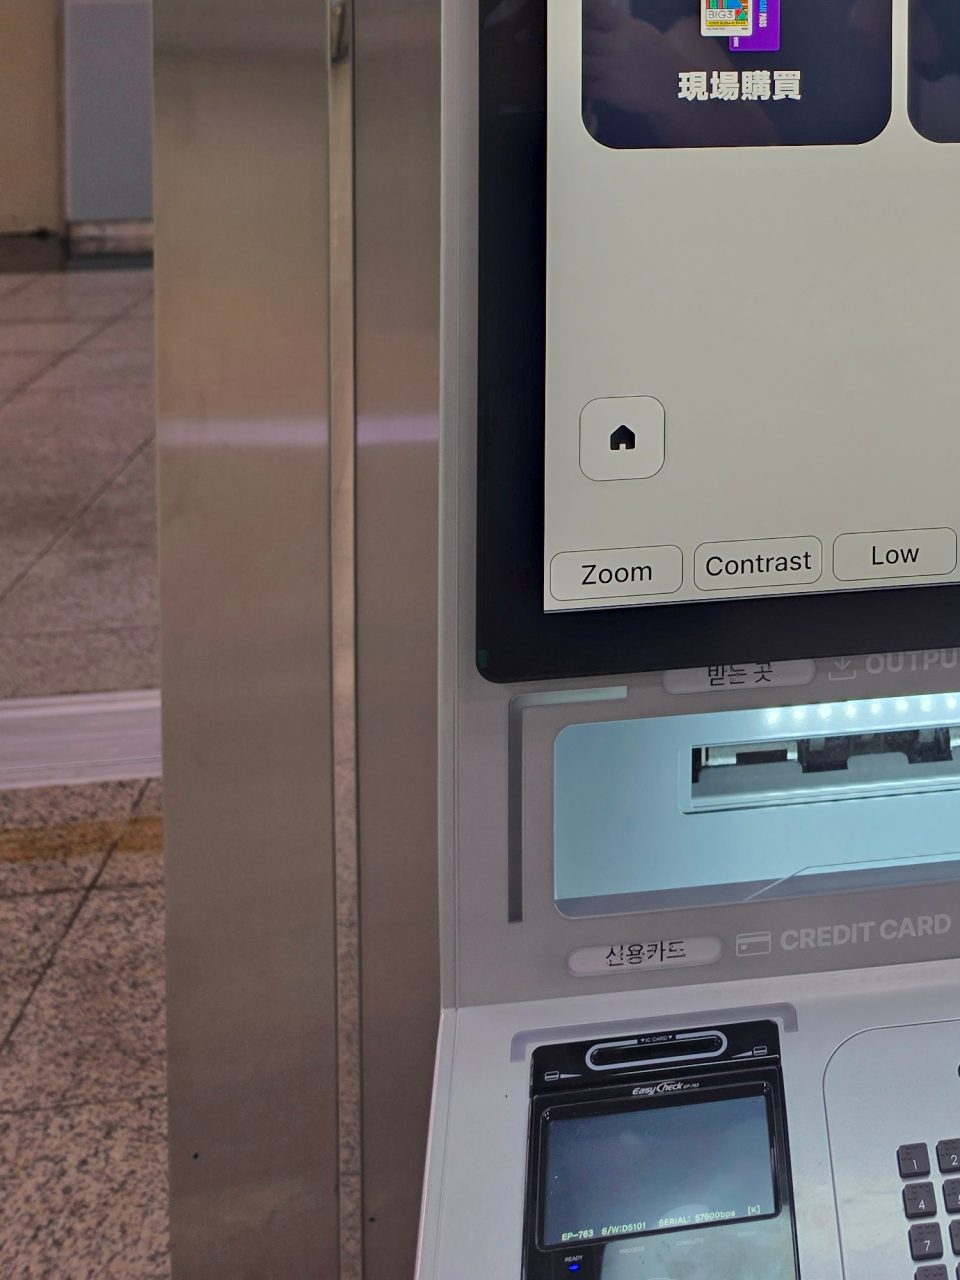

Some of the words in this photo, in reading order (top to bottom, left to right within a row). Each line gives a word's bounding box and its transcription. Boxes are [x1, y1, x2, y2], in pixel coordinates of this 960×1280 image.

[678, 71, 802, 101] 現場購買
[705, 550, 812, 578] Contrast
[871, 543, 919, 567] Low
[581, 561, 653, 586] Zoom
[780, 921, 876, 951] CREDIT
[879, 914, 952, 939] CARD
[606, 940, 687, 967] 신용카드
[912, 1159, 917, 1170] 1
[950, 1154, 958, 1165] 2
[918, 1199, 926, 1210] 4
[561, 1229, 594, 1241] EP-763
[602, 1222, 646, 1236] S/W:D5101
[924, 1241, 931, 1252] 7
